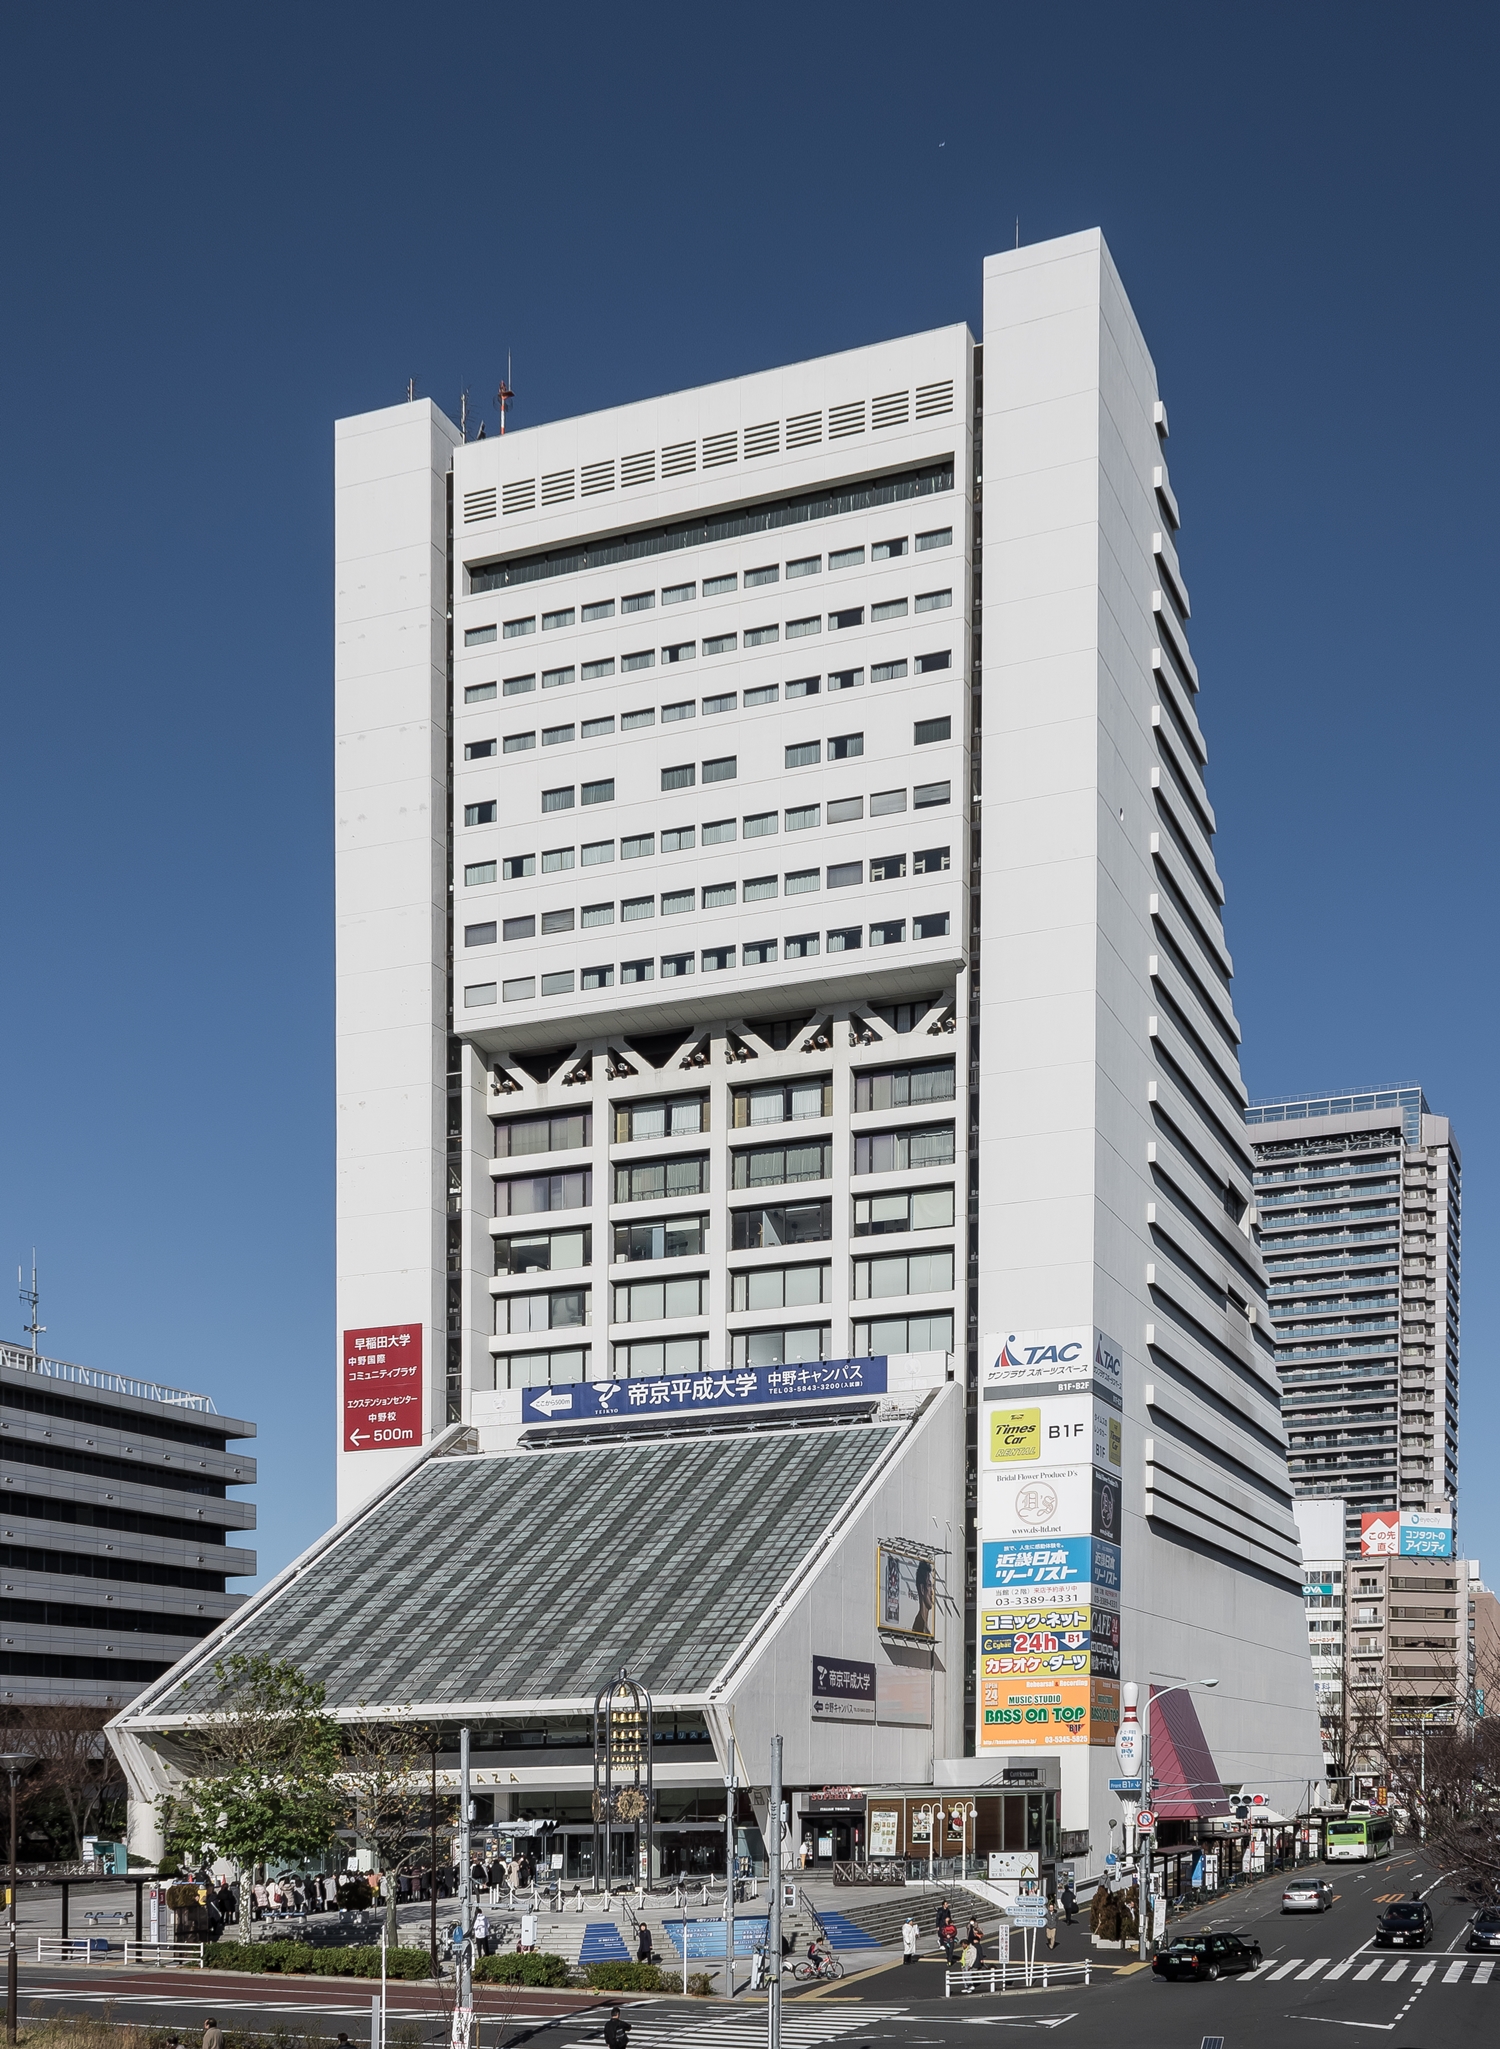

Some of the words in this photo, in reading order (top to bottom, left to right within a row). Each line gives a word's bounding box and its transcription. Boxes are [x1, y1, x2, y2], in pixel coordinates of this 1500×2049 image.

[354, 1333, 411, 1350] 早稲田大学
[348, 1354, 386, 1366] 中野国際
[1023, 1342, 1083, 1366] TAC
[1103, 1350, 1120, 1376] TAC
[348, 1366, 417, 1381] コミュニティプラザ
[768, 1364, 863, 1387] 中野キャンパス
[988, 1369, 1027, 1380] サンプラザ
[1027, 1364, 1088, 1377] スポーツスペース
[628, 1372, 757, 1406] 帝京平成大学
[347, 1395, 418, 1409] エクステンションセンター
[368, 1411, 397, 1423] 中野校
[373, 1428, 413, 1441] 500m
[996, 1424, 1036, 1435] Times
[1049, 1423, 1084, 1438] B1F
[1004, 1434, 1027, 1445] Car
[995, 1447, 1036, 1457] RENTAL
[1095, 1443, 1106, 1458] B1F
[996, 1474, 1016, 1482] Bridal
[1017, 1473, 1039, 1481] Flower
[1040, 1472, 1066, 1481] Produce
[1420, 1516, 1441, 1524] eyecity
[1368, 1531, 1397, 1541] この先
[1377, 1542, 1396, 1552] 直ぐ
[1405, 1540, 1446, 1553] アイシティ
[995, 1550, 1069, 1568] 近畿日本
[995, 1566, 1078, 1584] ツーリスト
[995, 1594, 1078, 1607] 03-3389-4331
[1091, 1612, 1112, 1636] CAFE
[1014, 1632, 1059, 1654] 24h
[1068, 1634, 1081, 1643] B1
[829, 1669, 871, 1691] 帝京平成大学
[985, 1689, 998, 1701] 24
[1008, 1695, 1033, 1705] MUSIC
[1033, 1694, 1061, 1704] STUDIO
[824, 1702, 854, 1714] 中野キャンパス
[985, 1708, 1022, 1724] BASS
[1053, 1706, 1085, 1722] TOP
